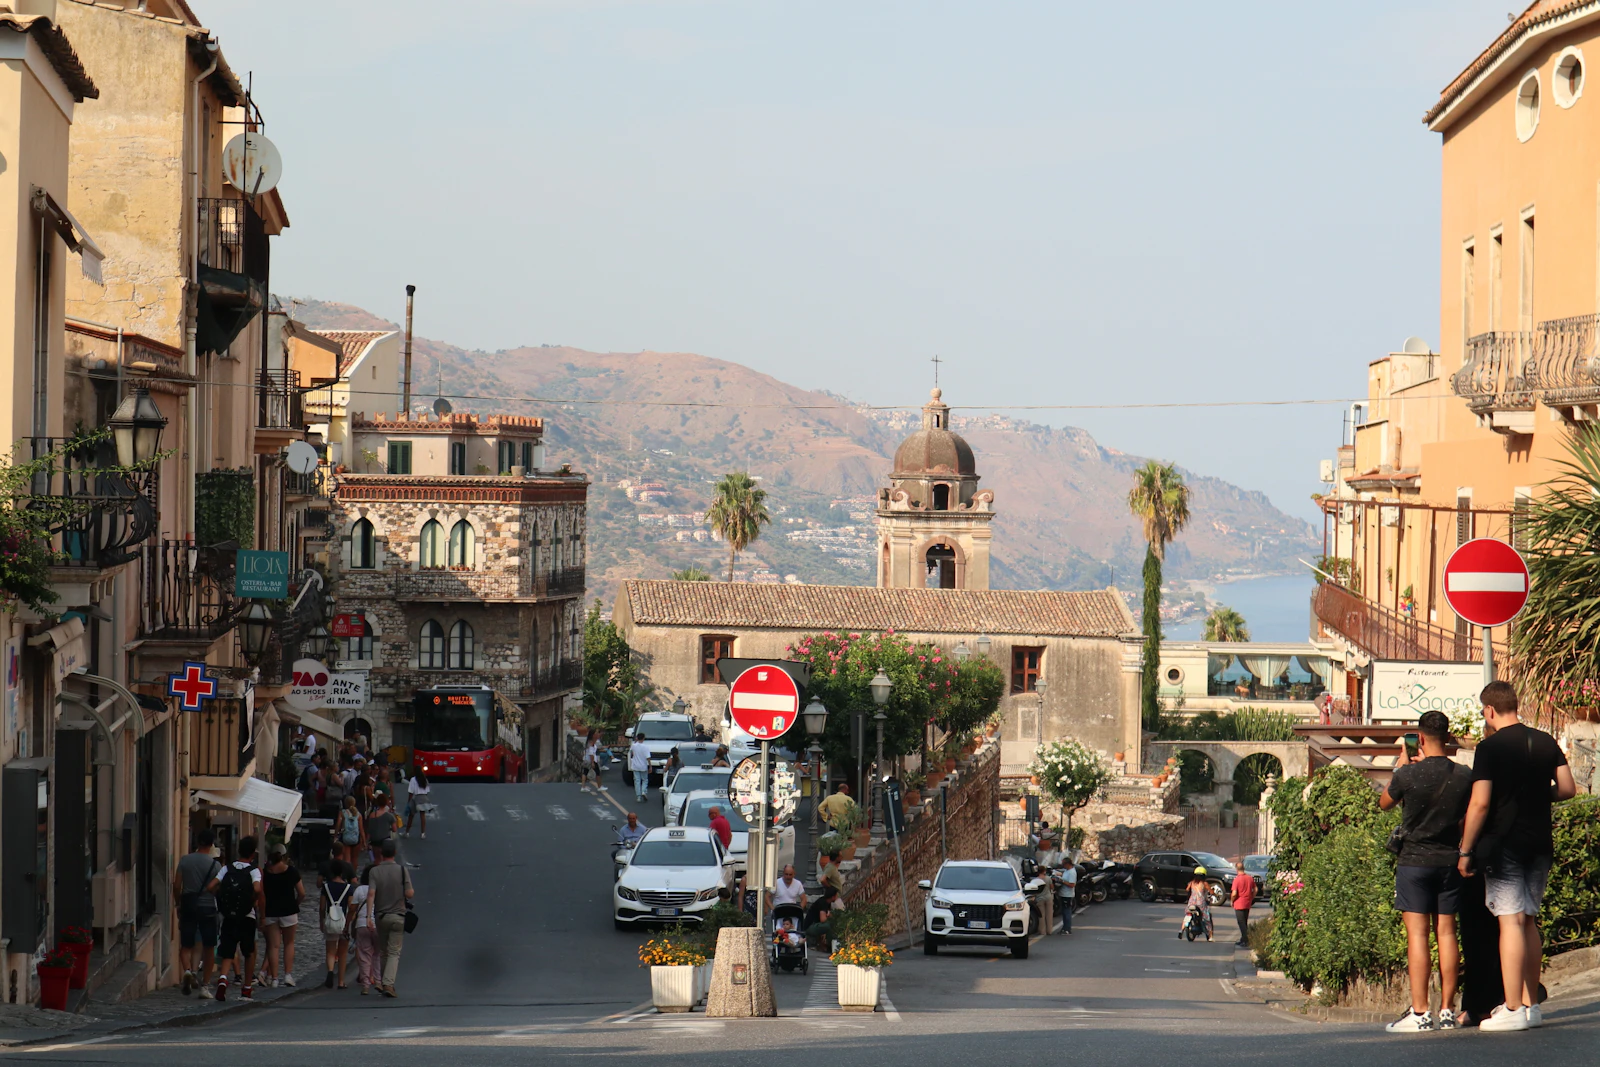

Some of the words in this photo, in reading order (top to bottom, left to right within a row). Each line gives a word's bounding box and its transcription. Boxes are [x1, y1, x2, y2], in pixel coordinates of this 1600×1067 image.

[1407, 668, 1450, 677] Ristorante
[332, 679, 361, 693] ANTE
[330, 687, 350, 695] RIA
[338, 697, 361, 705] Mare
[1379, 690, 1399, 709] La
